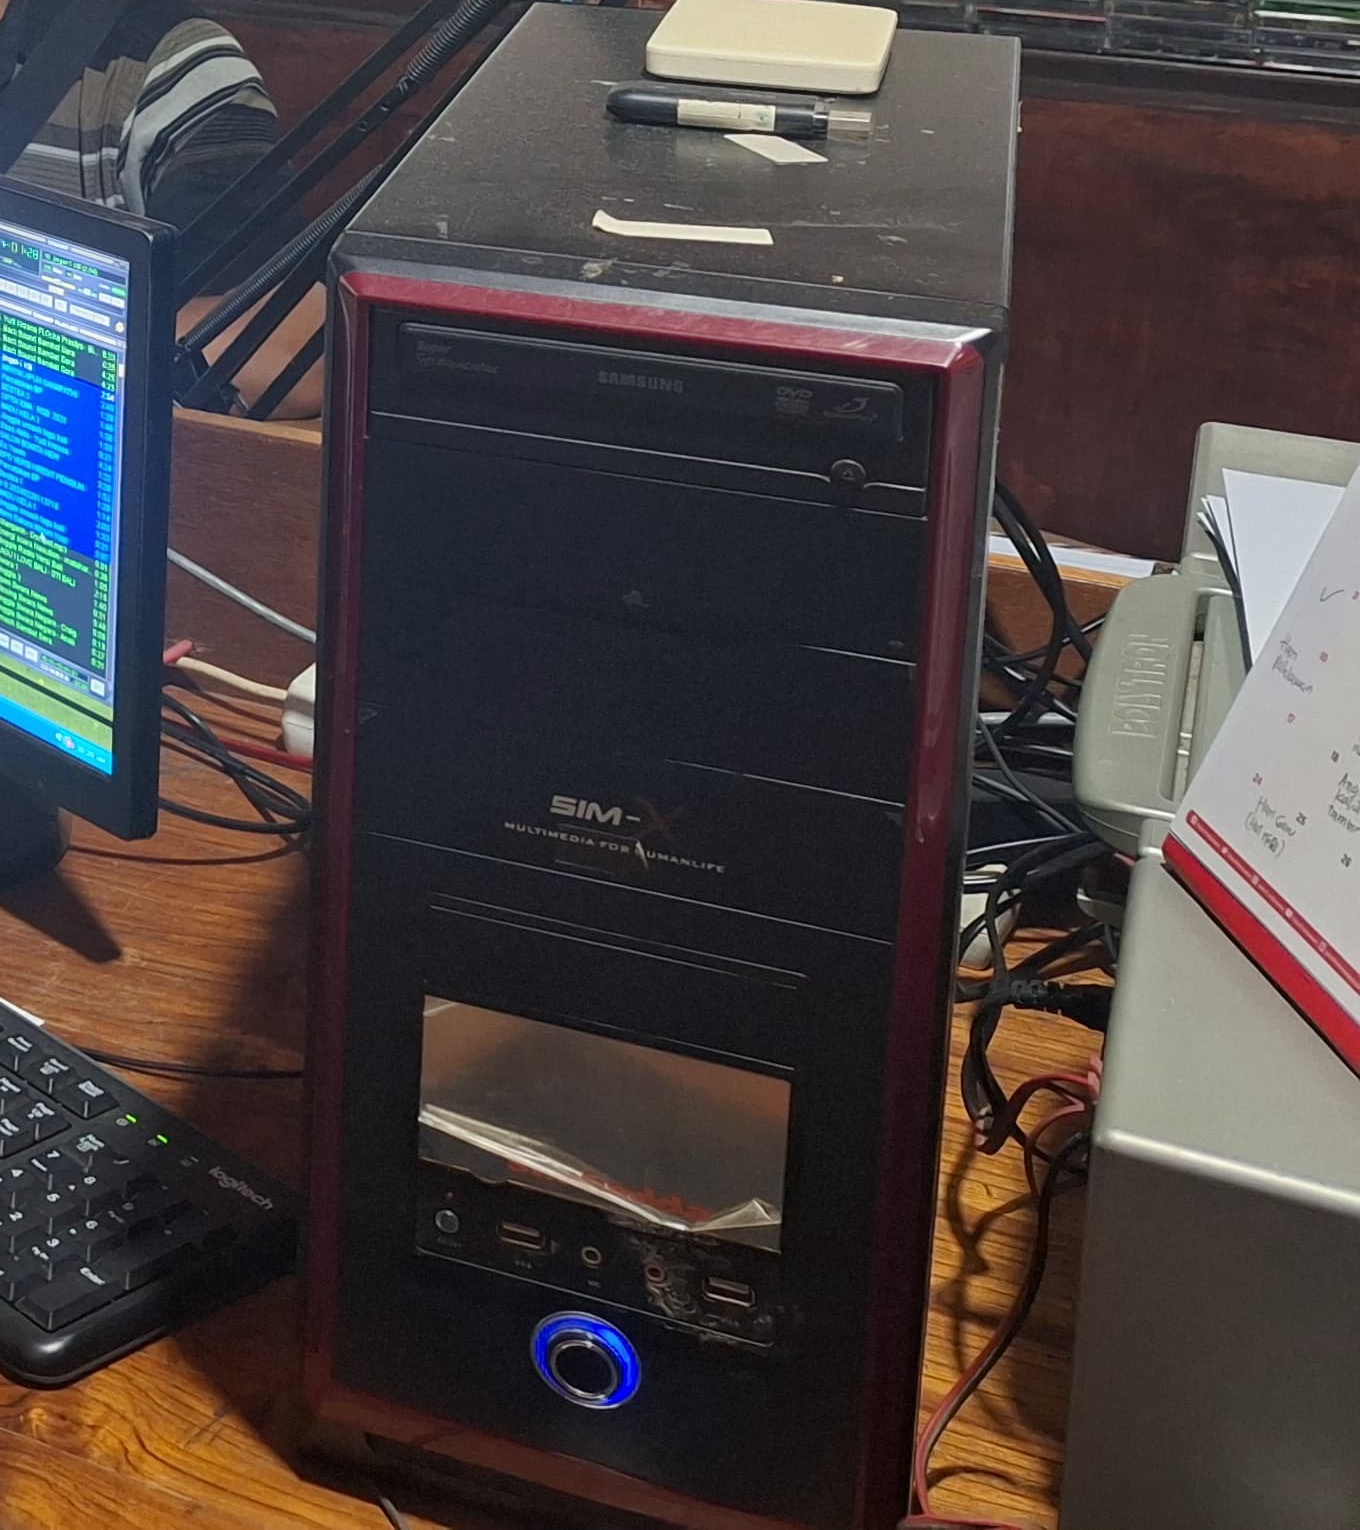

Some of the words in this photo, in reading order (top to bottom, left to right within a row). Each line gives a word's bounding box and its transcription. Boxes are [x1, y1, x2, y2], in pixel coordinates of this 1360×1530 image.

[598, 370, 684, 394] SAMSUNG
[504, 821, 595, 847] MULTIMEDIA
[599, 841, 630, 855] FOR
[208, 1164, 274, 1211] logitech
